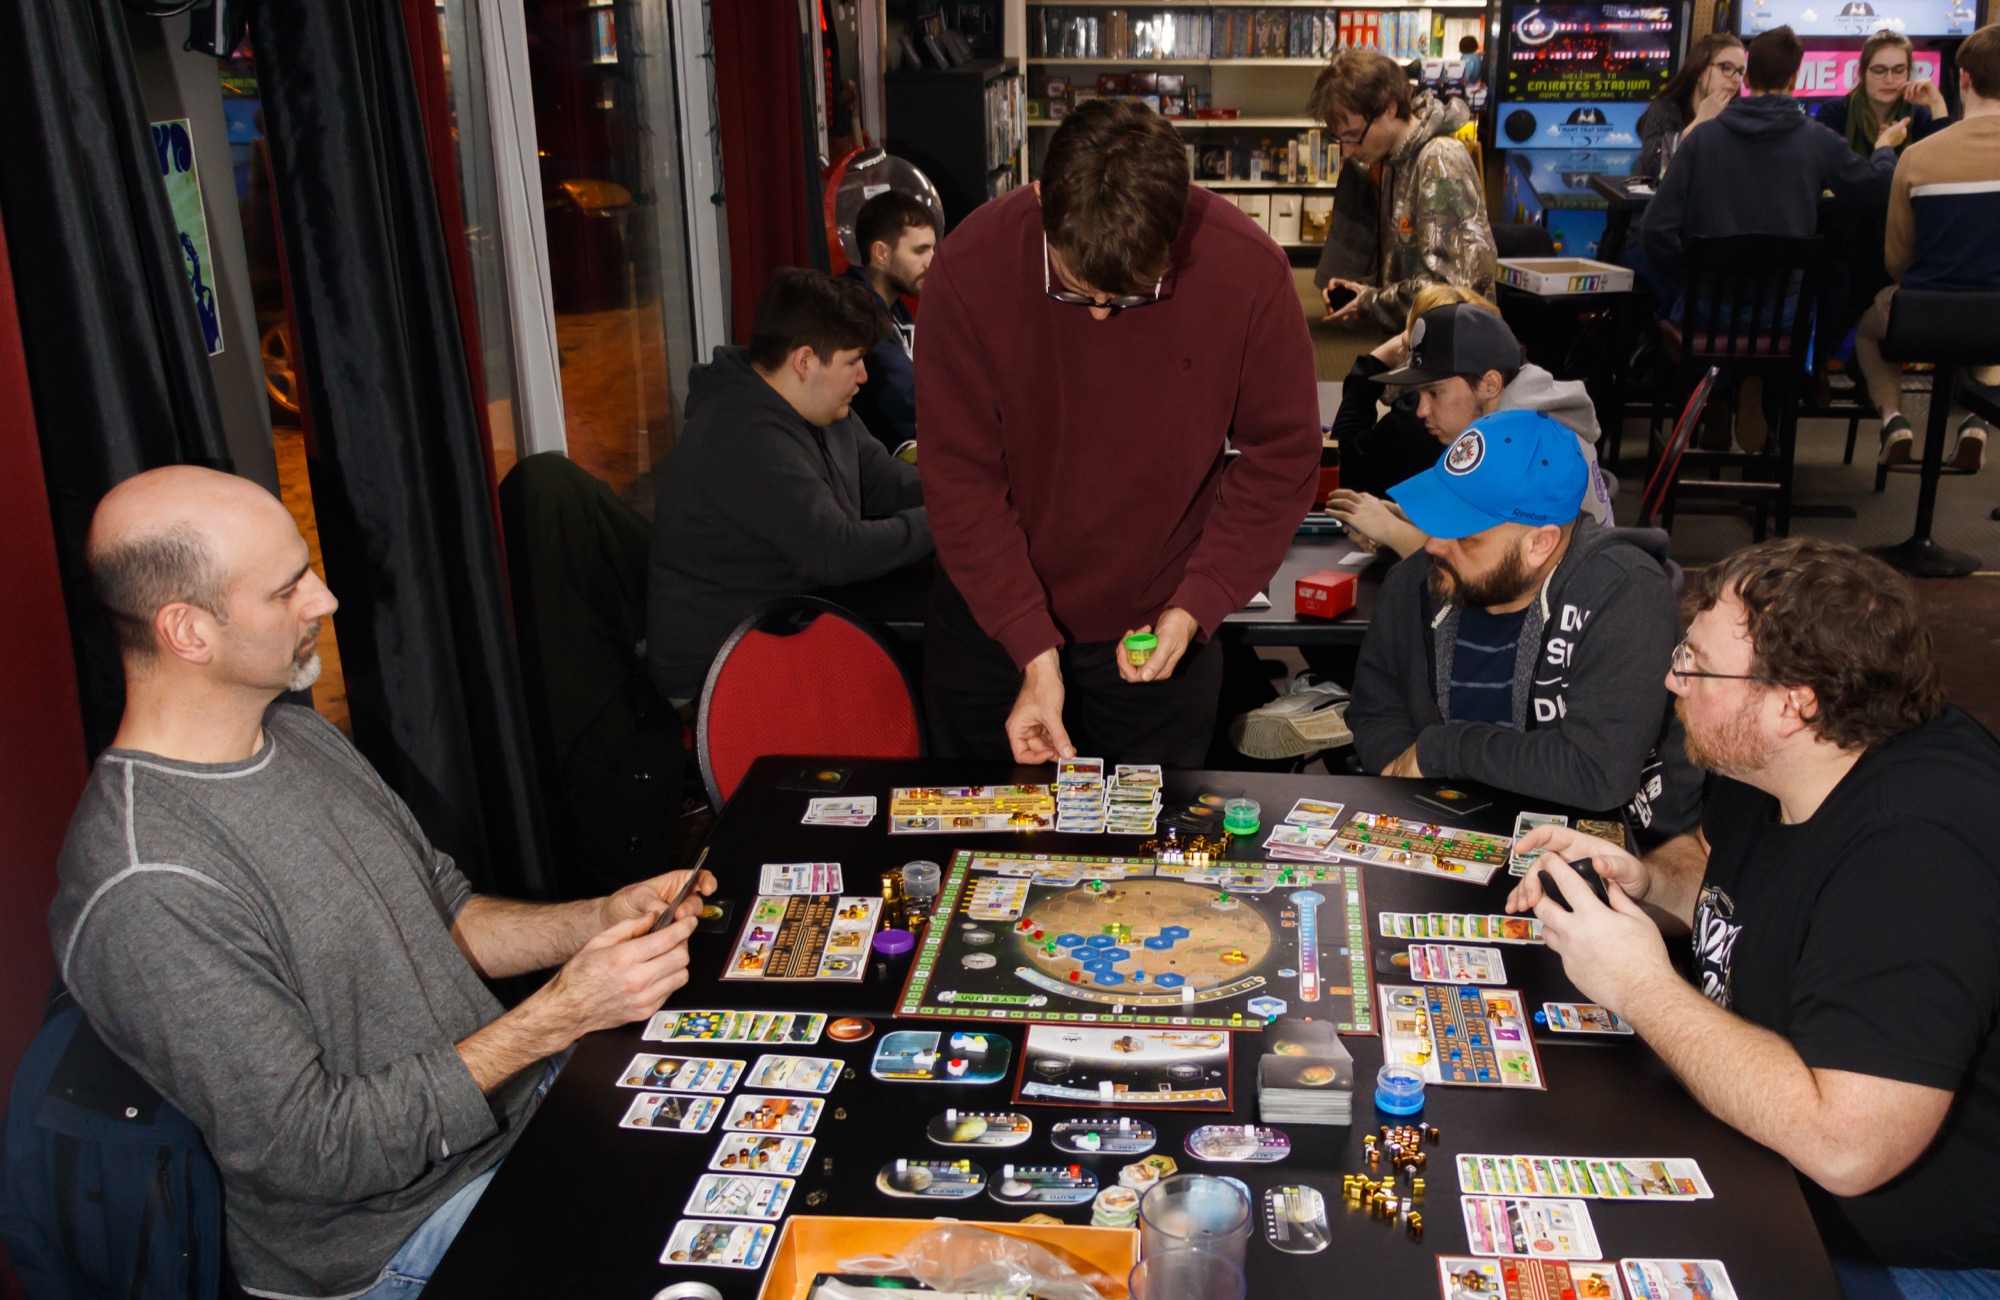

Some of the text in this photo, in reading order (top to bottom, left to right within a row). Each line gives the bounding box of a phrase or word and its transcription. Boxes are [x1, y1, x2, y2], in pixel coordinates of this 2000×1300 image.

[1795, 61, 1837, 90] ME
[1527, 80, 1651, 91] EMIRATES STADIUM
[1568, 276, 1600, 292] LIFE
[1512, 507, 1548, 522] Reebok
[961, 994, 1028, 1003] ELYSIUM
